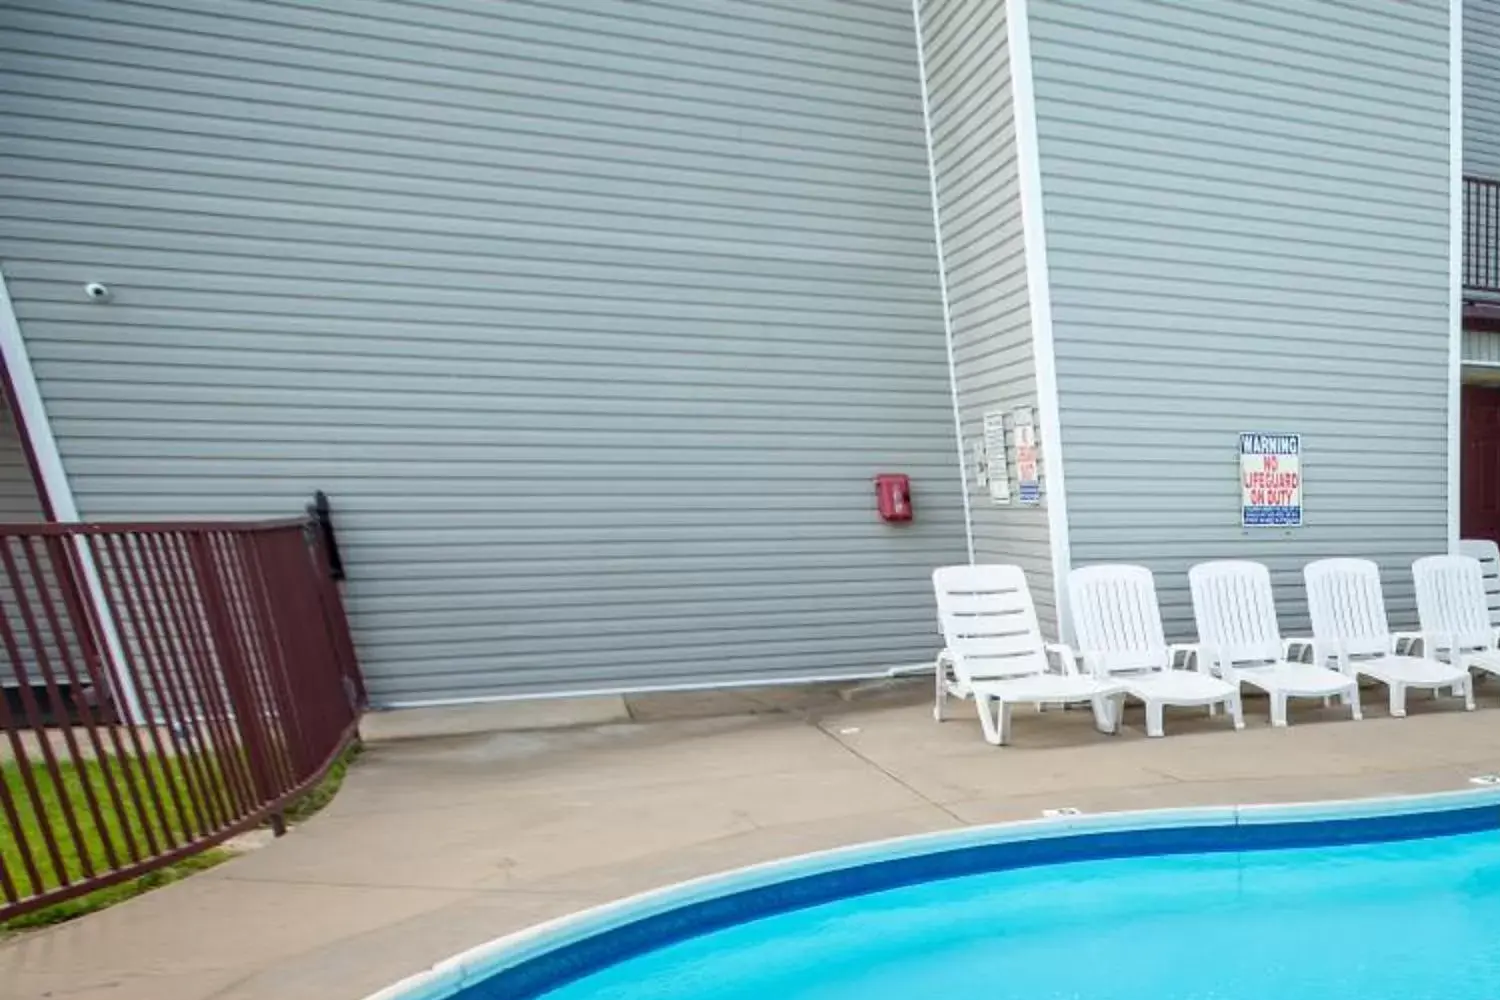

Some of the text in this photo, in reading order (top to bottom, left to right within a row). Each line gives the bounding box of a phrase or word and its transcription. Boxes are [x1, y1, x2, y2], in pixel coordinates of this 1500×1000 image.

[1241, 435, 1297, 454] WARNING
[1263, 456, 1278, 471] NO
[1244, 472, 1298, 488] LIFEGUARD
[1251, 489, 1292, 505] ON DUTY
